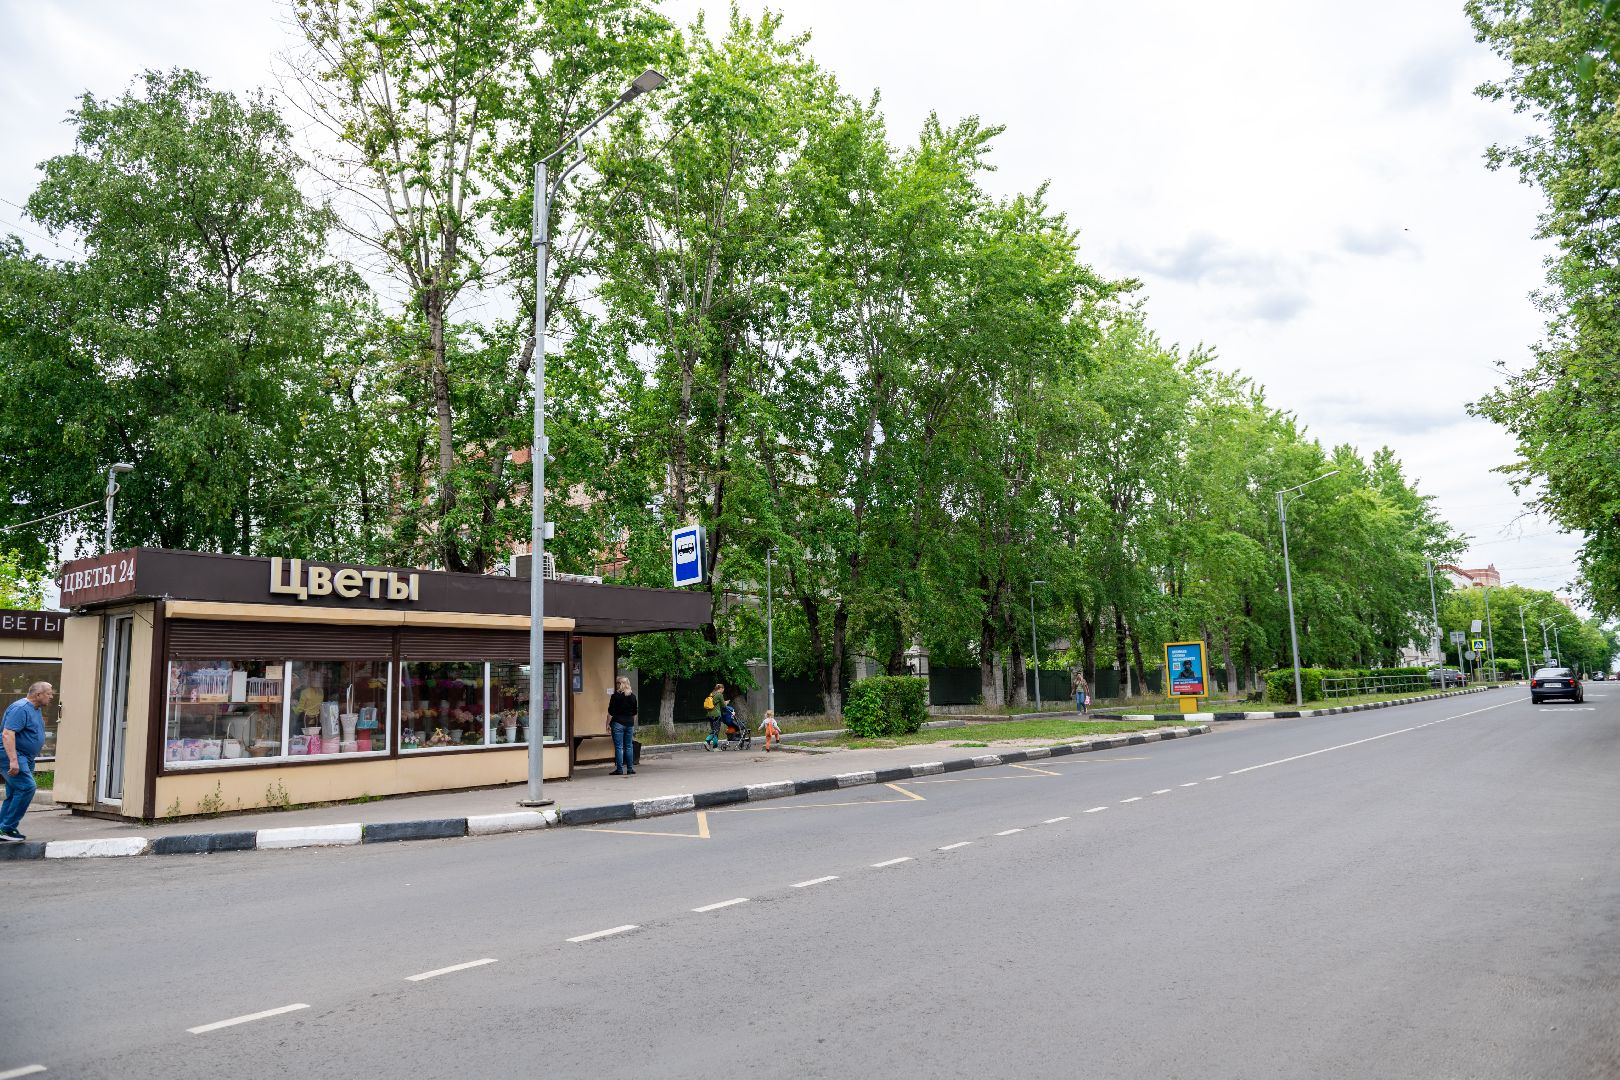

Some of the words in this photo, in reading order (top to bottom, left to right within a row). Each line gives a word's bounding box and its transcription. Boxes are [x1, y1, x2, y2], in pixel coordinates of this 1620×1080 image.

[63, 565, 116, 595] ЦВЕТЫ
[118, 557, 135, 583] 24
[270, 557, 419, 600] Цветы
[2, 615, 60, 632] ВЕТЫ
